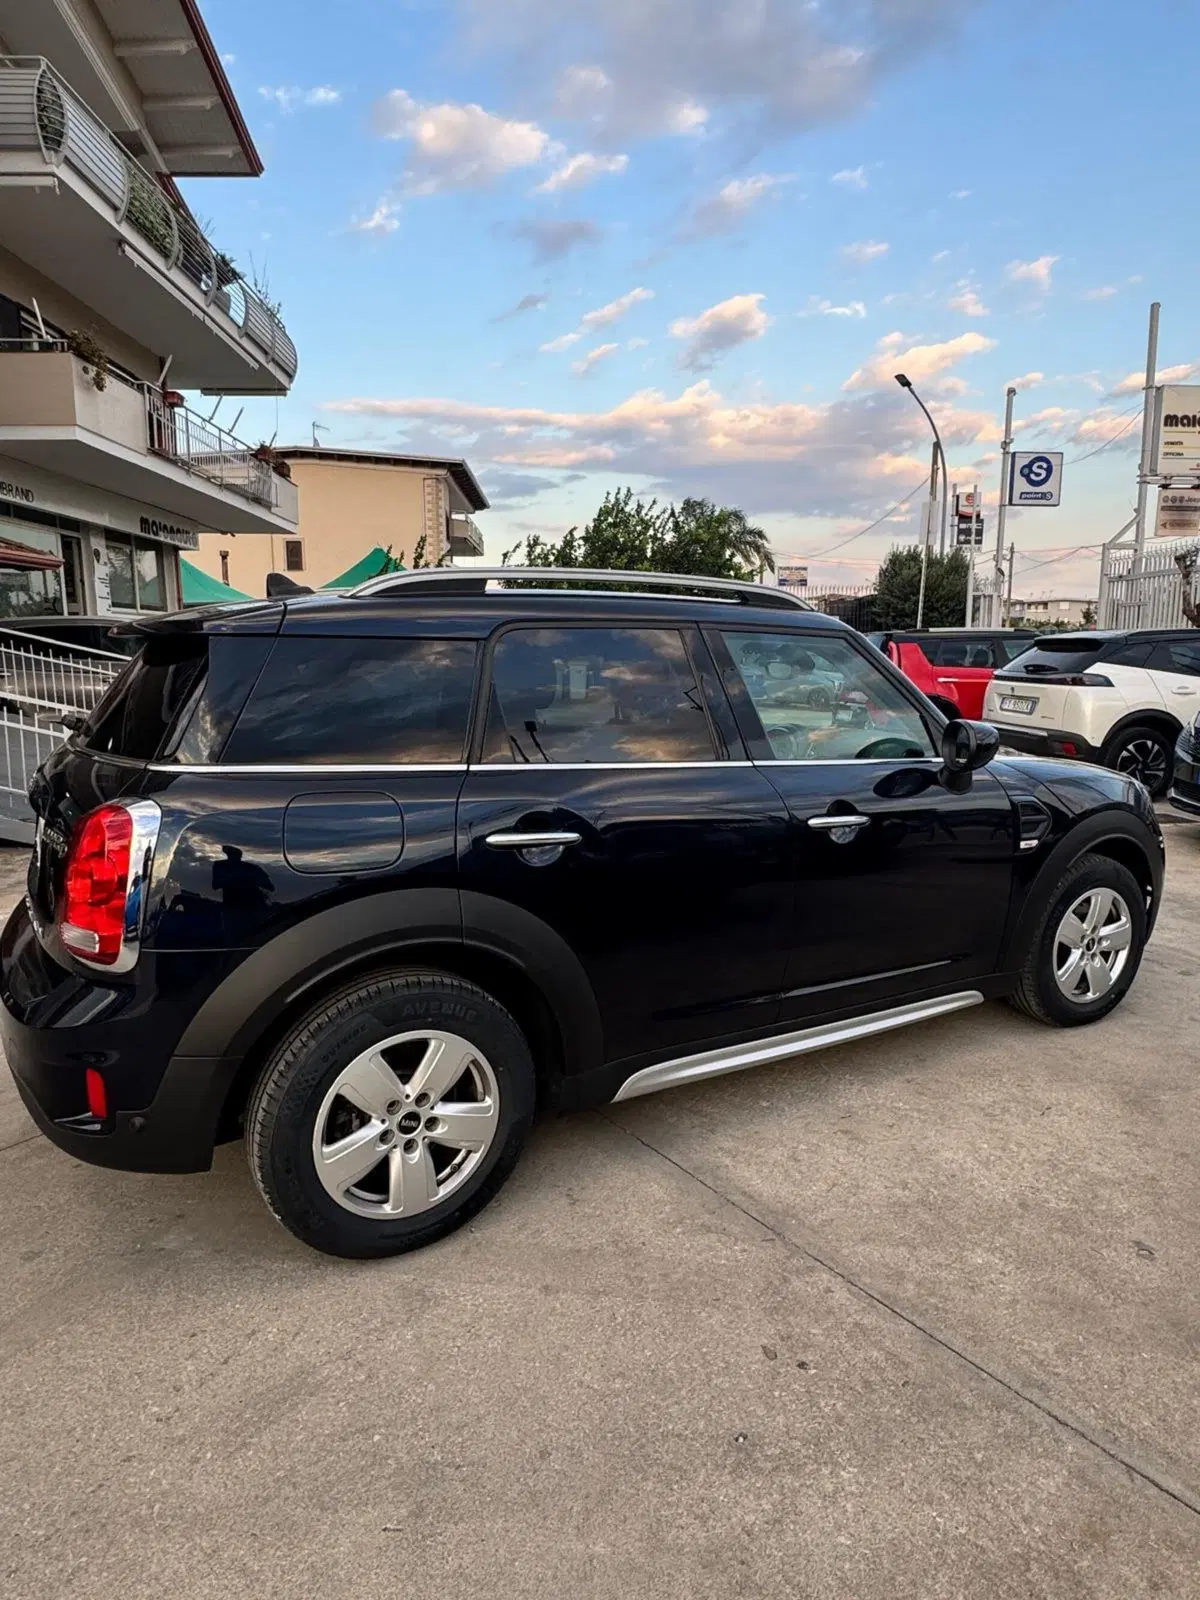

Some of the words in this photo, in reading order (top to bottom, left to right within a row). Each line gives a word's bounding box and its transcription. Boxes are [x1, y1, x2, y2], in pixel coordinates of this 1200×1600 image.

[1163, 413, 1200, 428] mai
[402, 1001, 477, 1022] AVENUE
[400, 1117, 420, 1128] MINI
